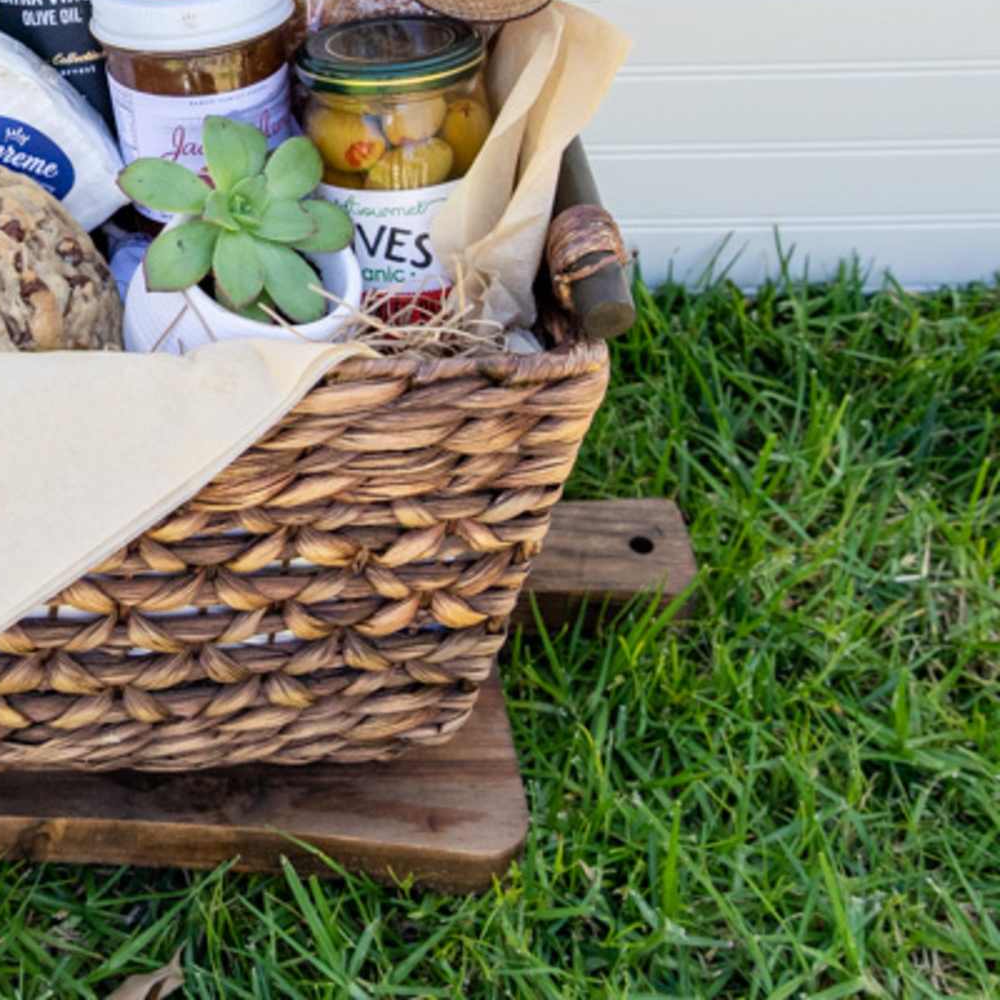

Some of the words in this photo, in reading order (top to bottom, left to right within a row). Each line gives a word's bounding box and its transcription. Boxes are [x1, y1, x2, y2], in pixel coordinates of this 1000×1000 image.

[22, 9, 58, 27] OLIVE
[59, 7, 83, 25] OIL
[350, 222, 433, 270] VES
[361, 265, 405, 284] anic
